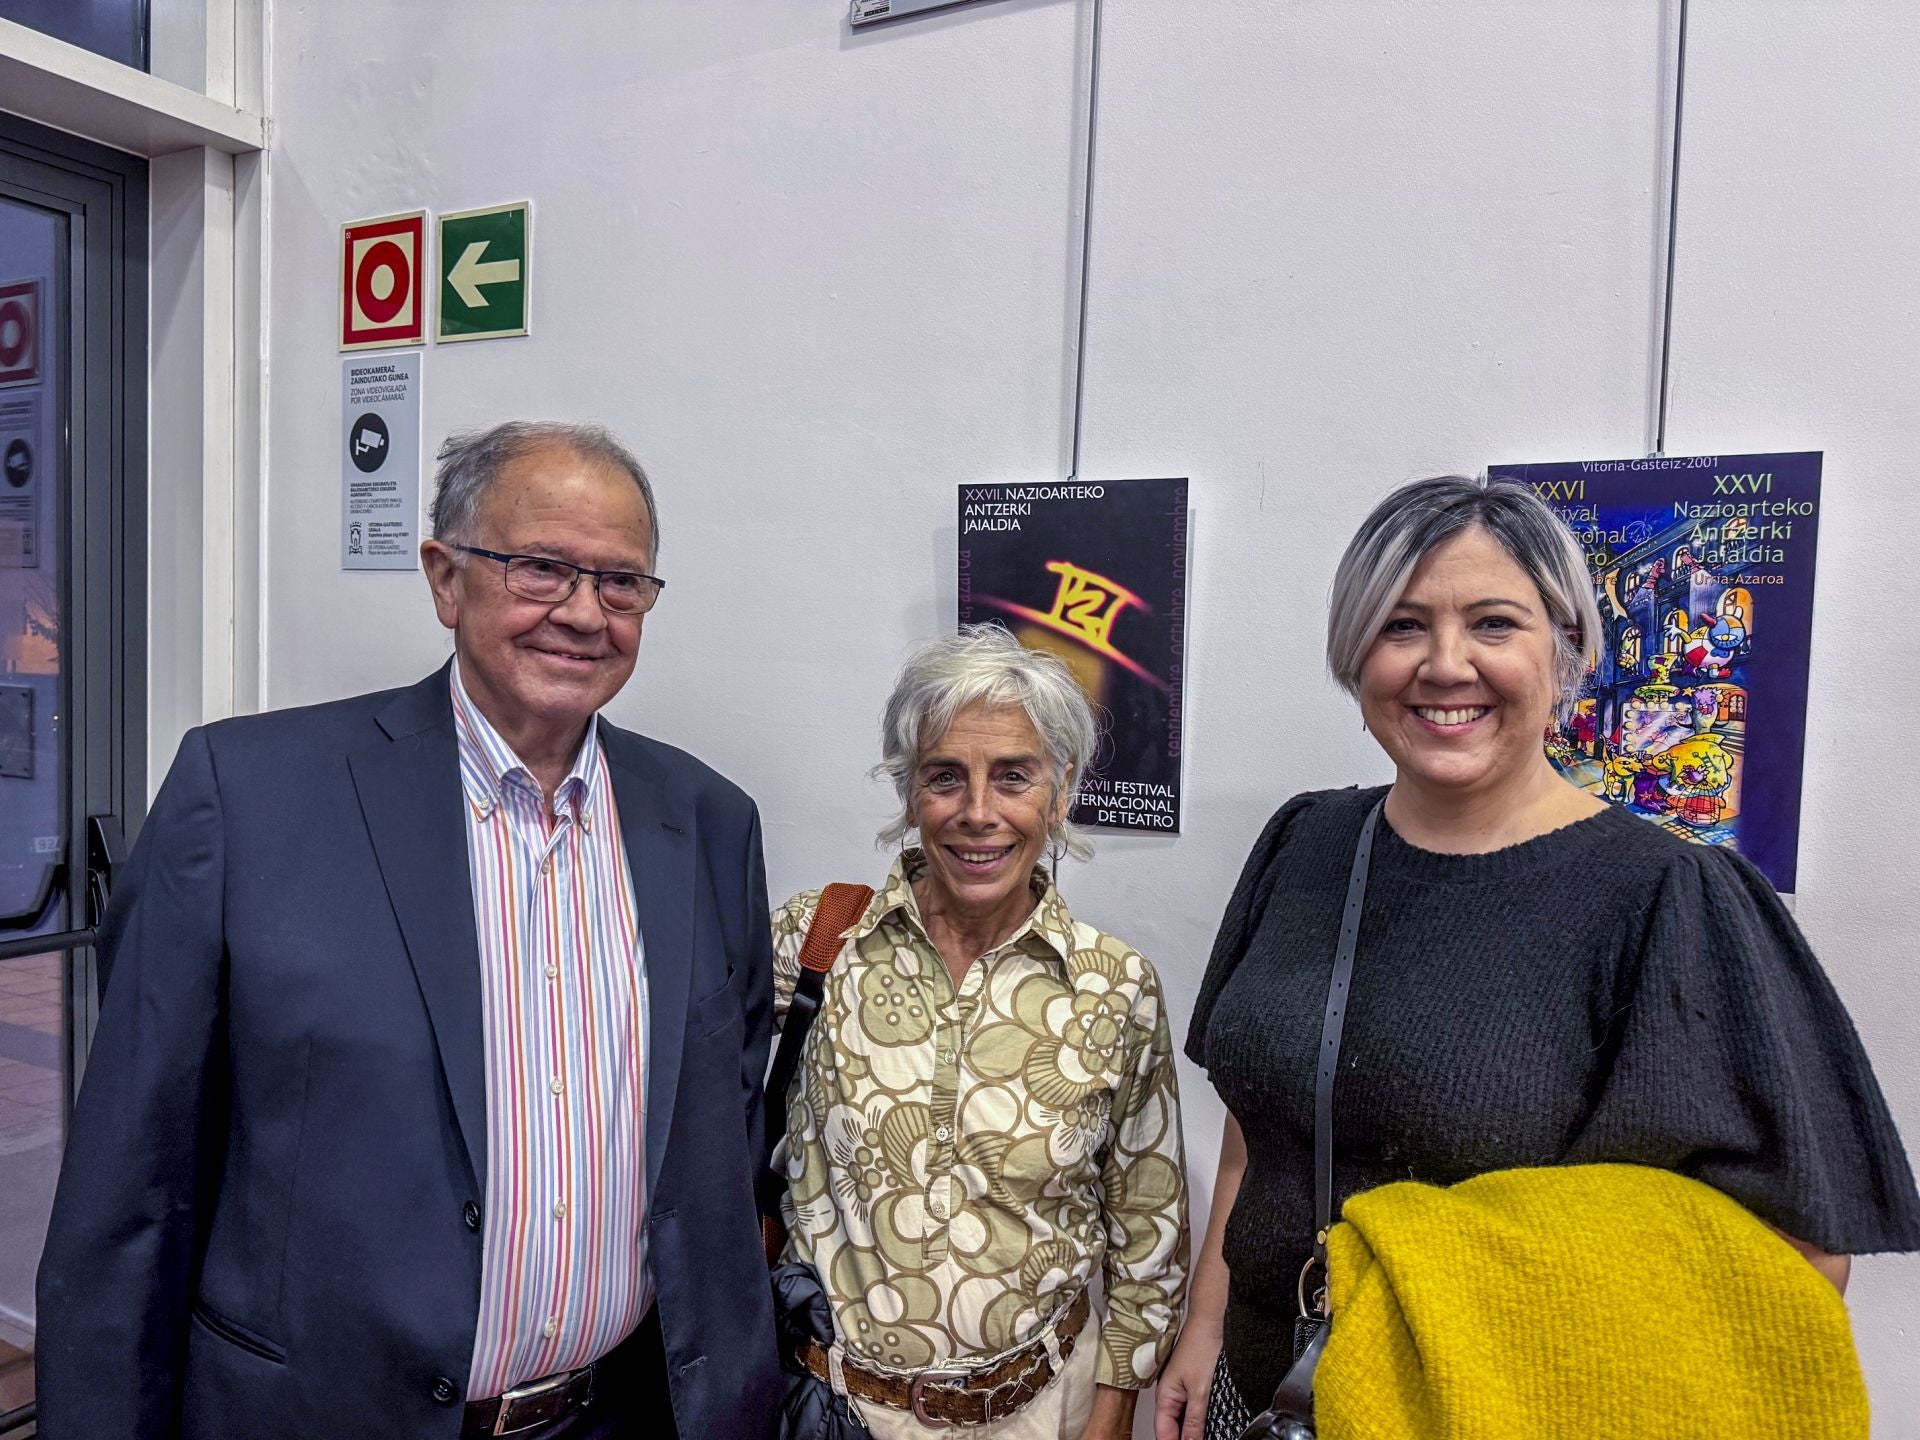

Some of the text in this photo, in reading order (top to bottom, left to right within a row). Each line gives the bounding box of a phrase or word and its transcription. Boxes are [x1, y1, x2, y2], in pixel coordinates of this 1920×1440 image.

[351, 365, 395, 376] BIDEOKAMERAZ
[351, 373, 408, 385] ZAINDUTAKO GUNEA
[351, 385, 407, 397] ZONA VIDEOVIGILADA
[362, 393, 405, 403] VIDEOCÁMARAS
[1582, 457, 1718, 472] Vitoria-Gasteiz-2001
[1712, 474, 1772, 495] XXVI
[965, 485, 1104, 501] XXVII. NAZIOARTEKO
[964, 503, 1031, 516] ANTZERKI
[1673, 497, 1813, 518] Nazioarteko
[963, 518, 1021, 534] JAIALDIA
[1689, 521, 1793, 541] Antzerki
[1696, 545, 1784, 563] Jaialdia
[1694, 574, 1784, 585] Urria-Azaroa
[1115, 781, 1175, 798] FESTIVAL
[1075, 793, 1175, 813] TERNACIONAL
[1098, 809, 1174, 828] DE TEATRO
